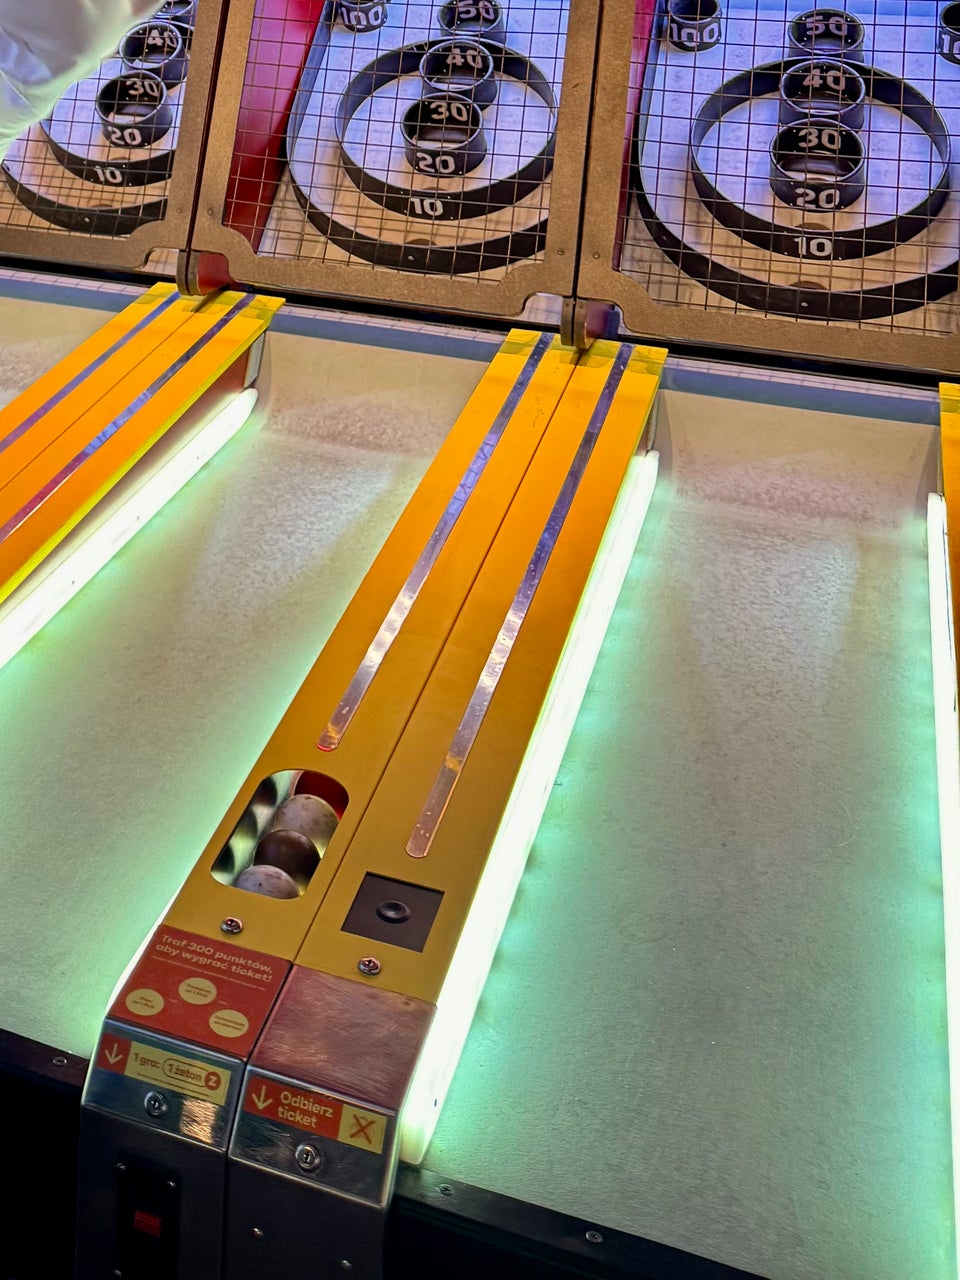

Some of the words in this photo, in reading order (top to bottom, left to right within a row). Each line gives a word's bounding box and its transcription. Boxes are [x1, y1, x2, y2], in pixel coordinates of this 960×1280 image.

[341, 5, 385, 28] 100
[460, 1, 496, 21] 50
[670, 22, 721, 47] 100
[805, 16, 848, 36] 50
[147, 30, 179, 47] 40
[446, 47, 483, 70] 40
[126, 77, 159, 98] 30
[802, 68, 847, 91] 40
[429, 100, 468, 121] 30
[107, 126, 142, 146] 20
[798, 127, 841, 150] 30
[416, 151, 455, 174] 20
[93, 166, 123, 184] 10
[409, 196, 444, 216] 10
[794, 187, 841, 210] 20
[794, 236, 832, 256] 10
[155, 943, 180, 957] aby
[181, 950, 229, 971] wygrać
[231, 964, 273, 983] ticket!
[161, 934, 187, 950] Traf
[187, 940, 214, 956] 300
[215, 950, 273, 974] punktów,
[140, 1055, 160, 1069] gra:
[174, 1065, 202, 1083] żeton
[280, 1091, 334, 1118] Odbierz
[277, 1106, 318, 1128] ticket
